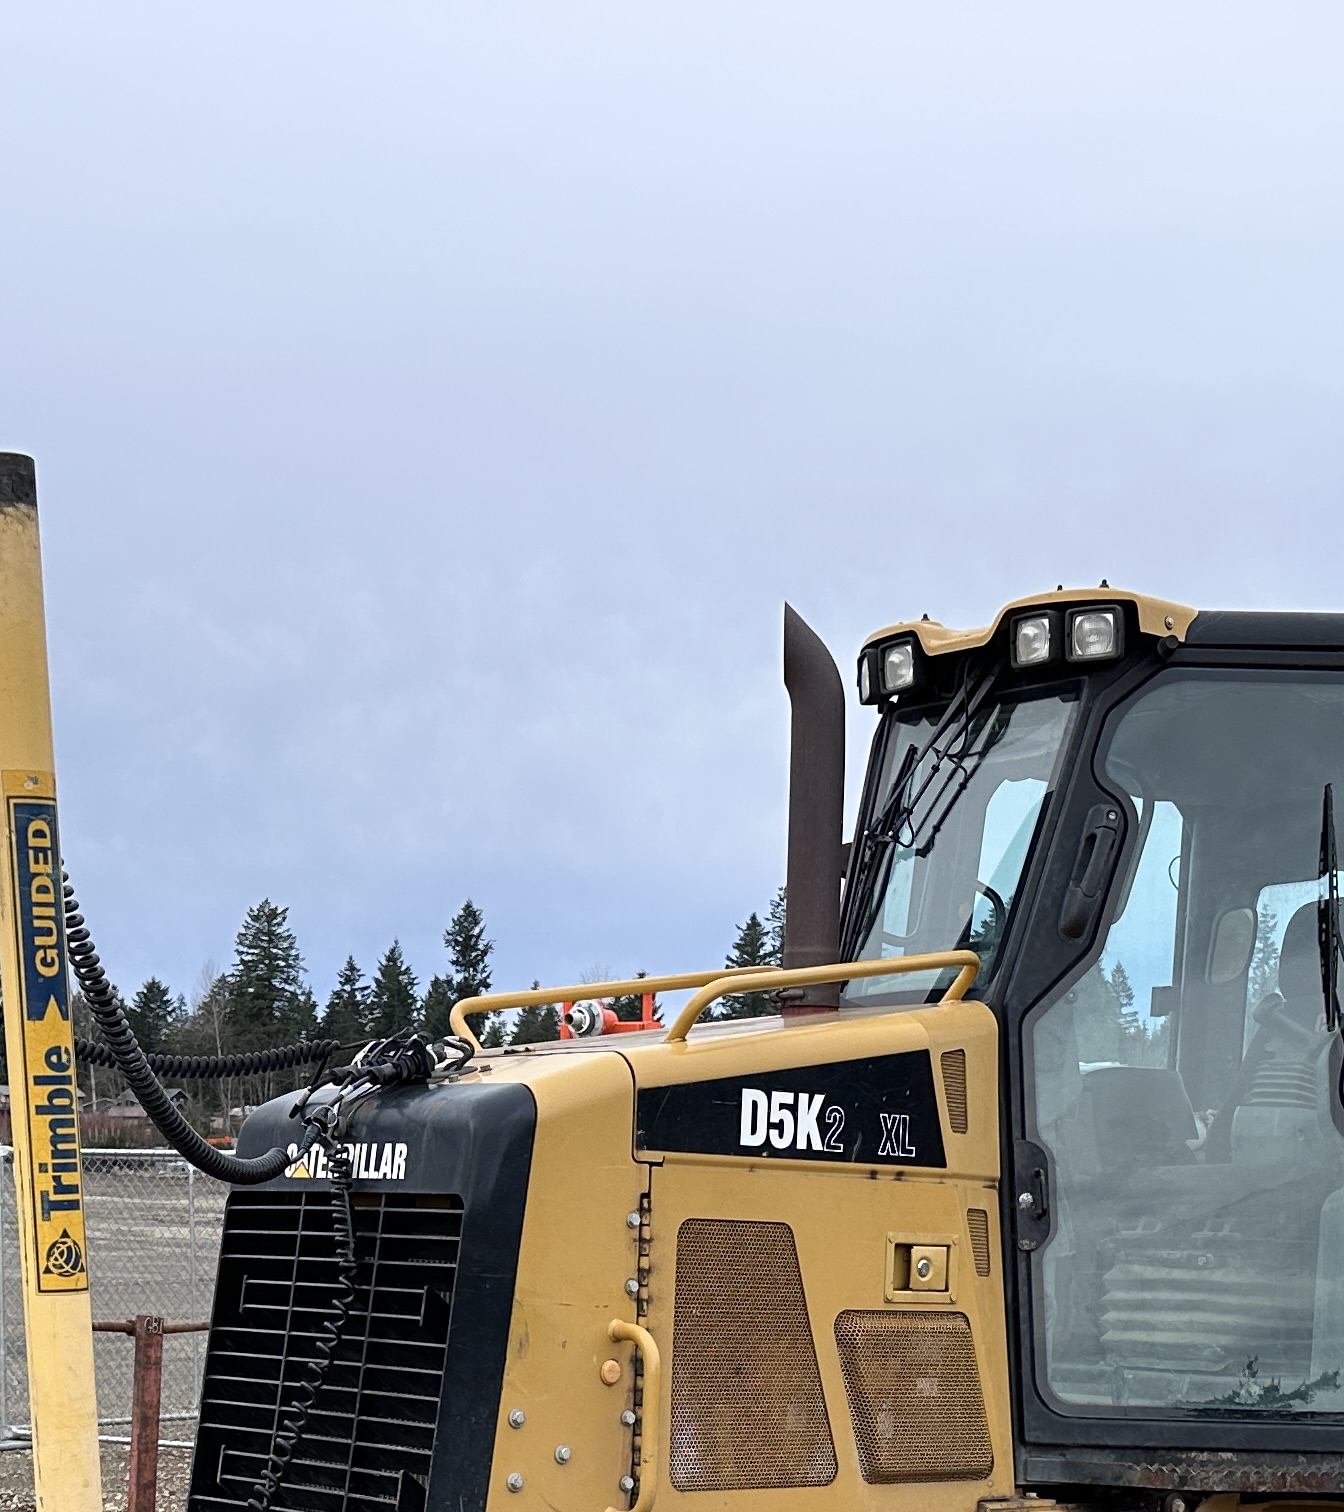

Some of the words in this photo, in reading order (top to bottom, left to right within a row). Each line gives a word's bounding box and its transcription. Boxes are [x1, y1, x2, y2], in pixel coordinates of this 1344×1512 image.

[27, 819, 60, 978] GUIDED
[33, 1044, 81, 1222] Trimble
[877, 1113, 916, 1158] XL
